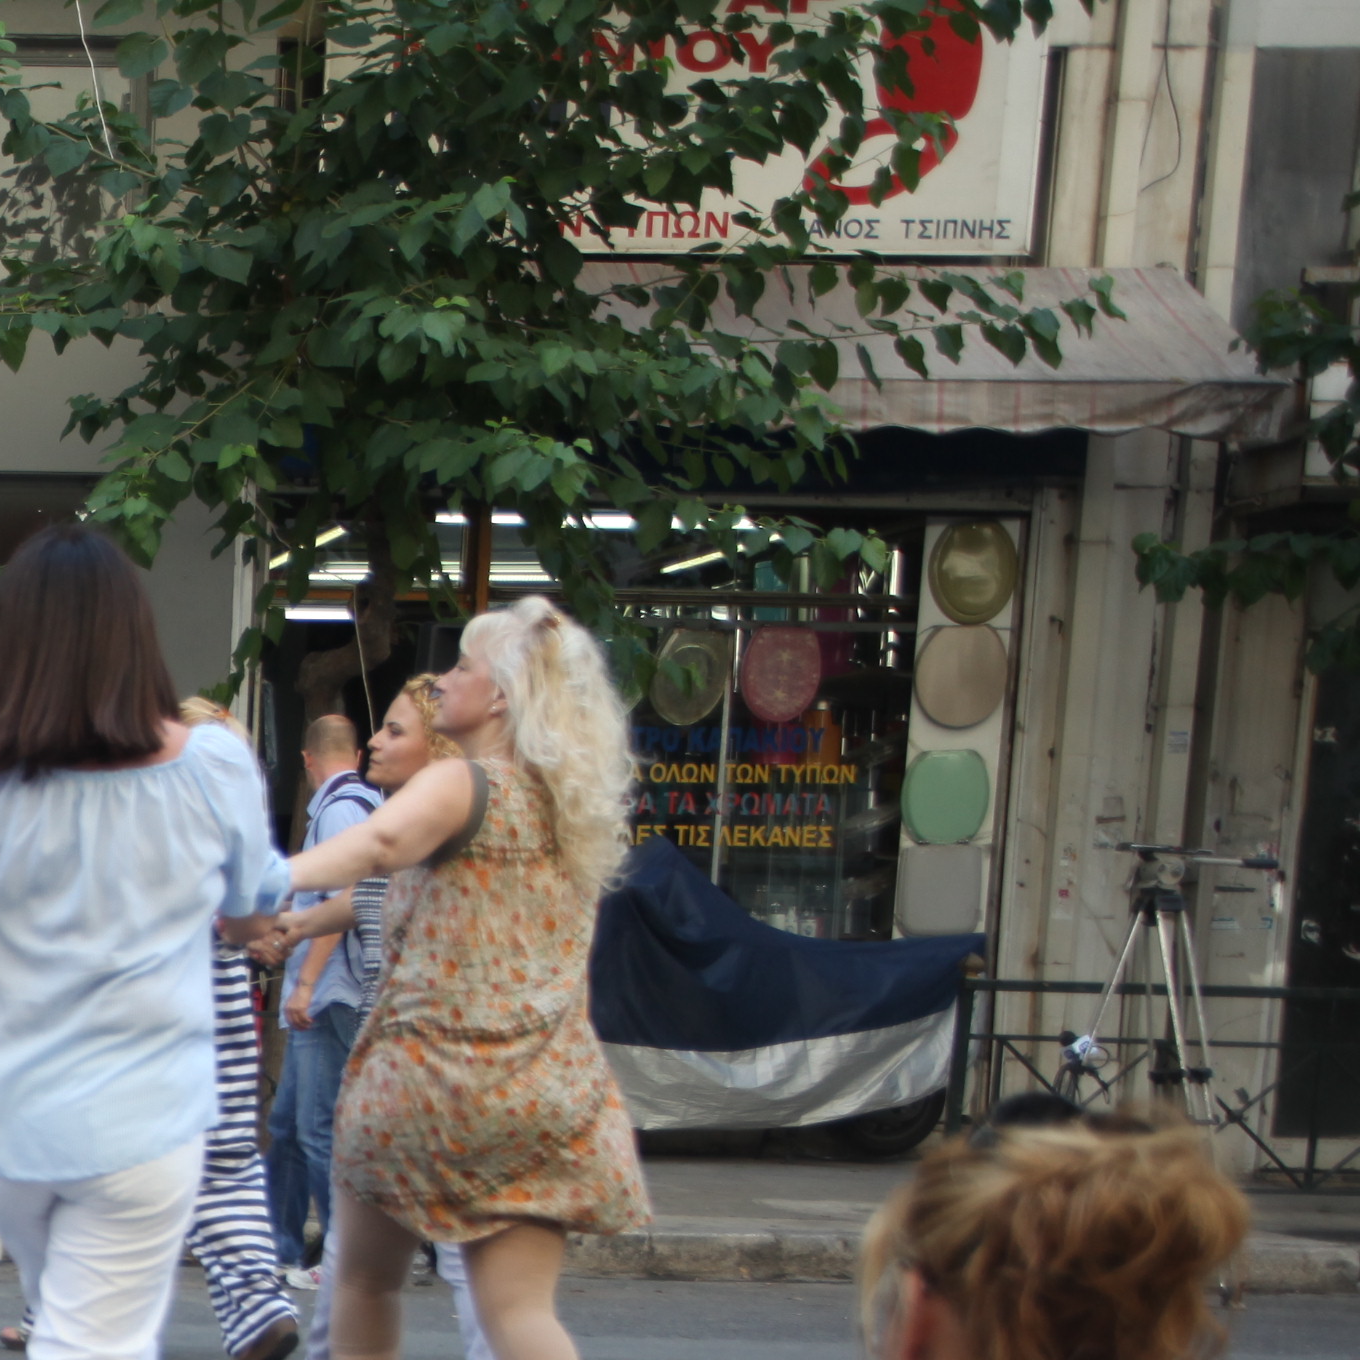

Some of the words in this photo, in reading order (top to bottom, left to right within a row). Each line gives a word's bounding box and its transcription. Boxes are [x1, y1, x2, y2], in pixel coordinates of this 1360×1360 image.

[799, 218, 880, 240] ΑΝΟΣ
[900, 218, 1012, 240] ΤΣΙΠΝΗΣ
[650, 763, 715, 784] ΟΛΩΝ
[726, 764, 770, 784] ΤΩΝ
[777, 764, 857, 784] ΤΥΠΩΝ
[674, 825, 710, 846] ΤΙΣ
[717, 825, 833, 848] ΛΕΚΑΝΕΣ
